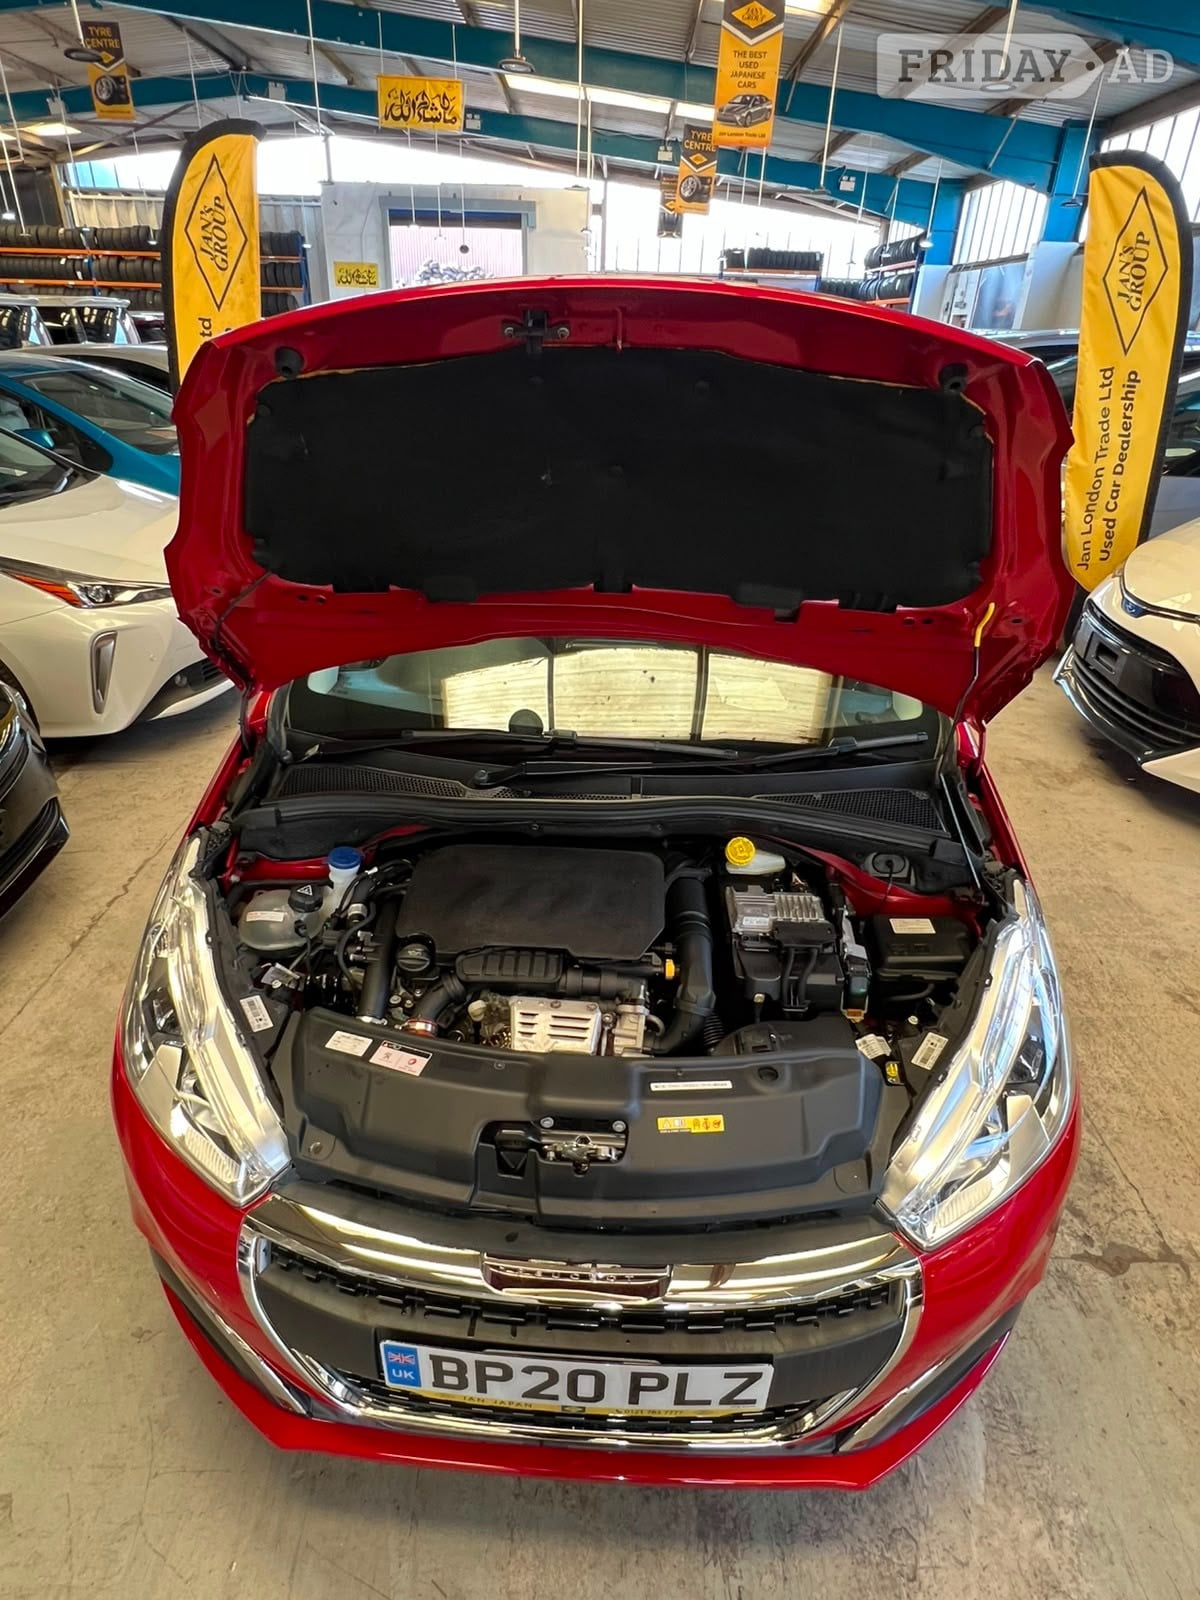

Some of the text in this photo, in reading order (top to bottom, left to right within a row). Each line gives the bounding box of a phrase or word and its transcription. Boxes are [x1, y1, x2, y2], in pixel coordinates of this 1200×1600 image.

[88, 26, 112, 37] TYRE
[85, 38, 120, 48] CENTRE
[733, 50, 767, 59] THE BEST
[739, 61, 759, 69] USED
[730, 71, 766, 79] JAPANESE
[737, 81, 757, 89] CARS
[684, 139, 716, 152] CENTRE
[211, 196, 228, 271] GROUP
[1130, 231, 1150, 312] GROUP
[198, 317, 212, 338] td
[1076, 366, 1115, 571] Jan London Trade Ltd
[1099, 370, 1141, 562] Used Car Dealership
[392, 1369, 414, 1381] UK
[429, 1354, 763, 1407] BP20 PLZ
